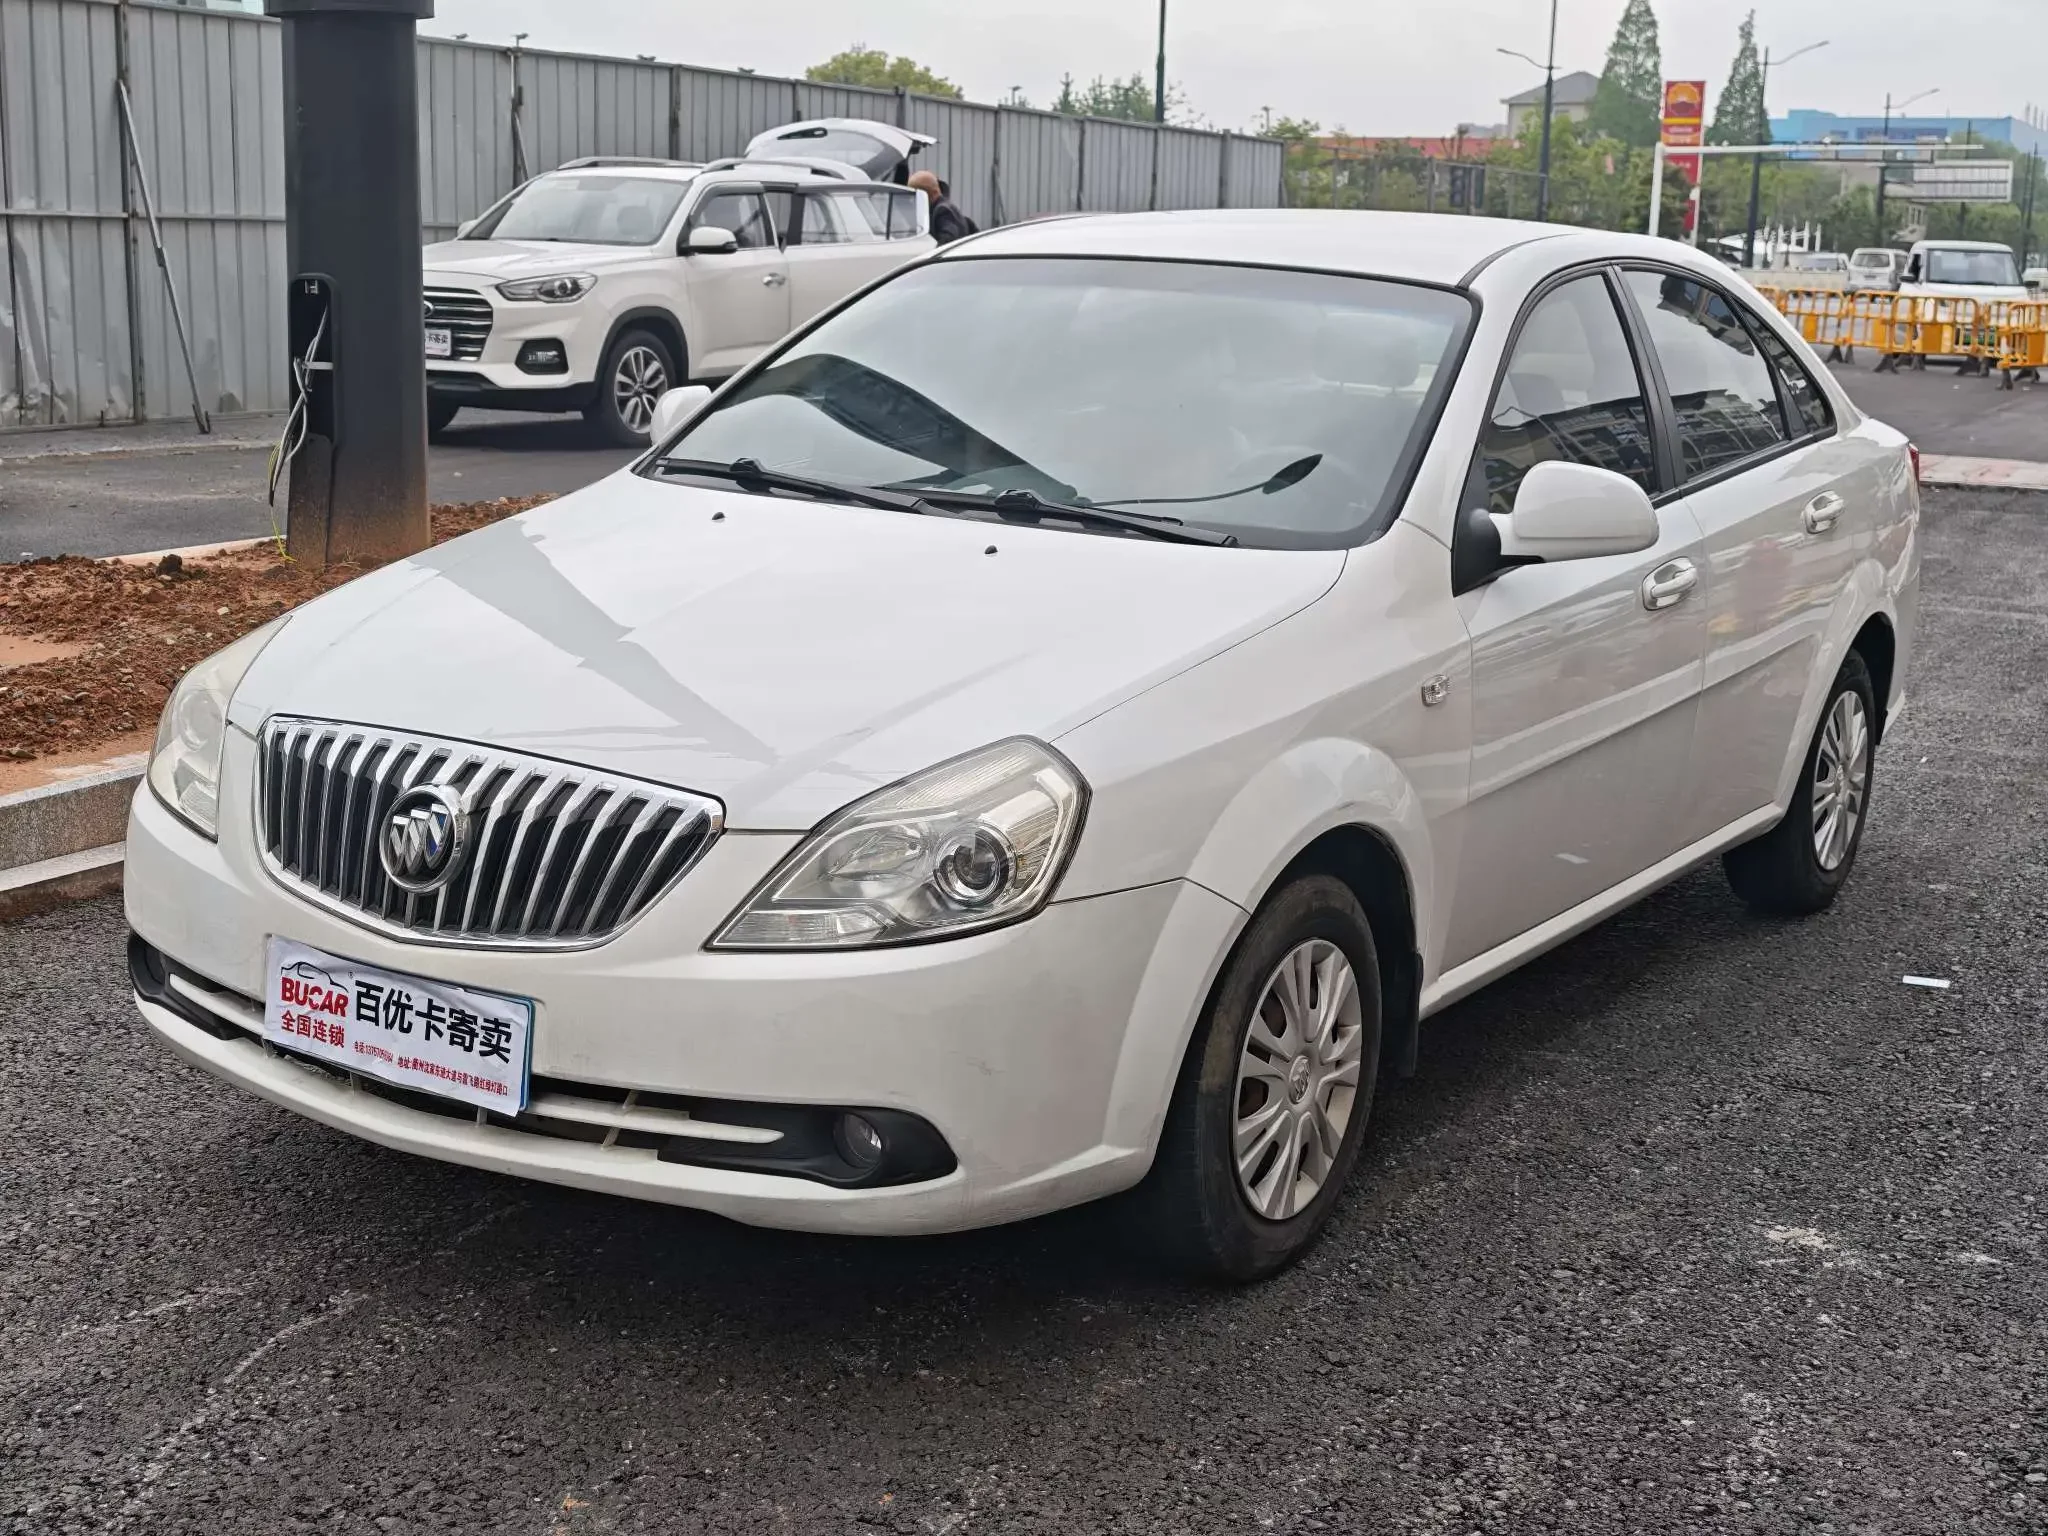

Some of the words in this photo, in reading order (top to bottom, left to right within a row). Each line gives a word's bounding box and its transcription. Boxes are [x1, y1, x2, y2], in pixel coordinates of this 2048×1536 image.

[281, 977, 349, 1017] BUCAR
[281, 1010, 345, 1048] 全国连锁
[355, 979, 512, 1063] 百优卡寄卖
